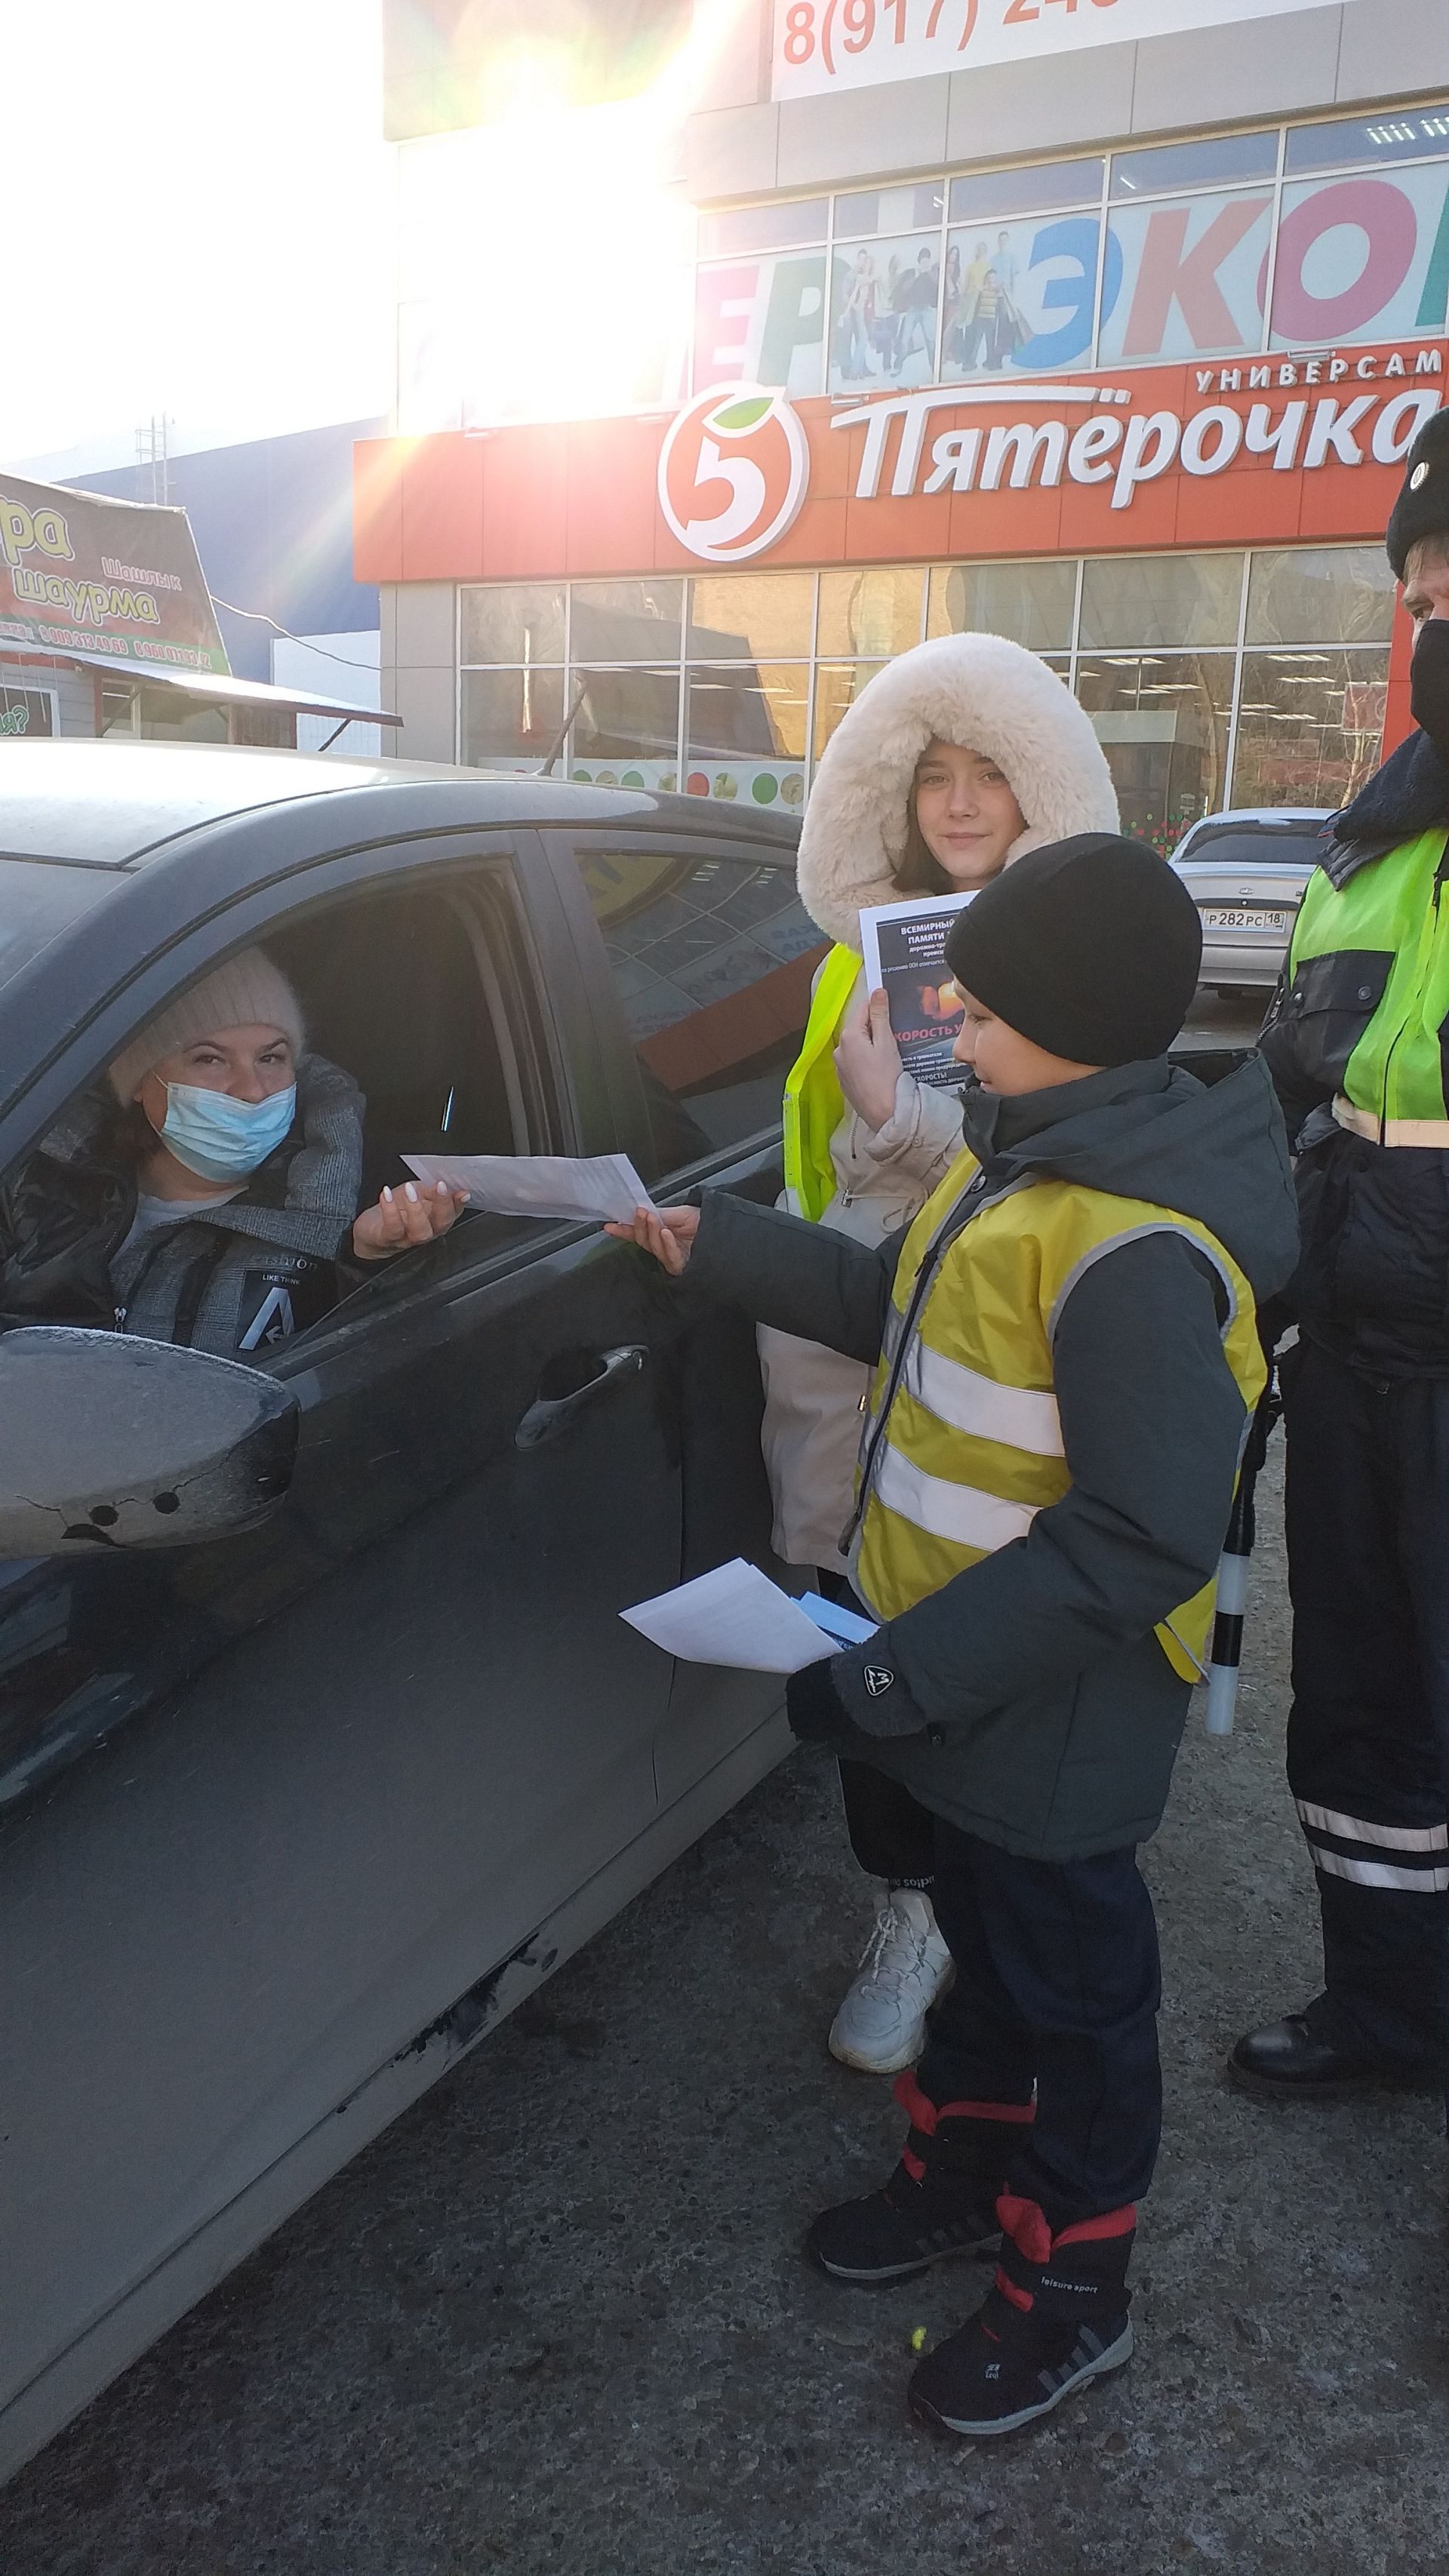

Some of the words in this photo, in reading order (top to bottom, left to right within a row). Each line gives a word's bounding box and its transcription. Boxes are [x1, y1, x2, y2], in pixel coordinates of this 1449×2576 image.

[1195, 348, 1443, 394] УНИВЕРСАМ
[102, 556, 182, 592] Шашлык
[12, 567, 161, 626] шаурма
[908, 932, 945, 944] ПАМЯТИ
[1041, 2276, 1073, 2290] leisure
[1073, 2285, 1099, 2294] sport
